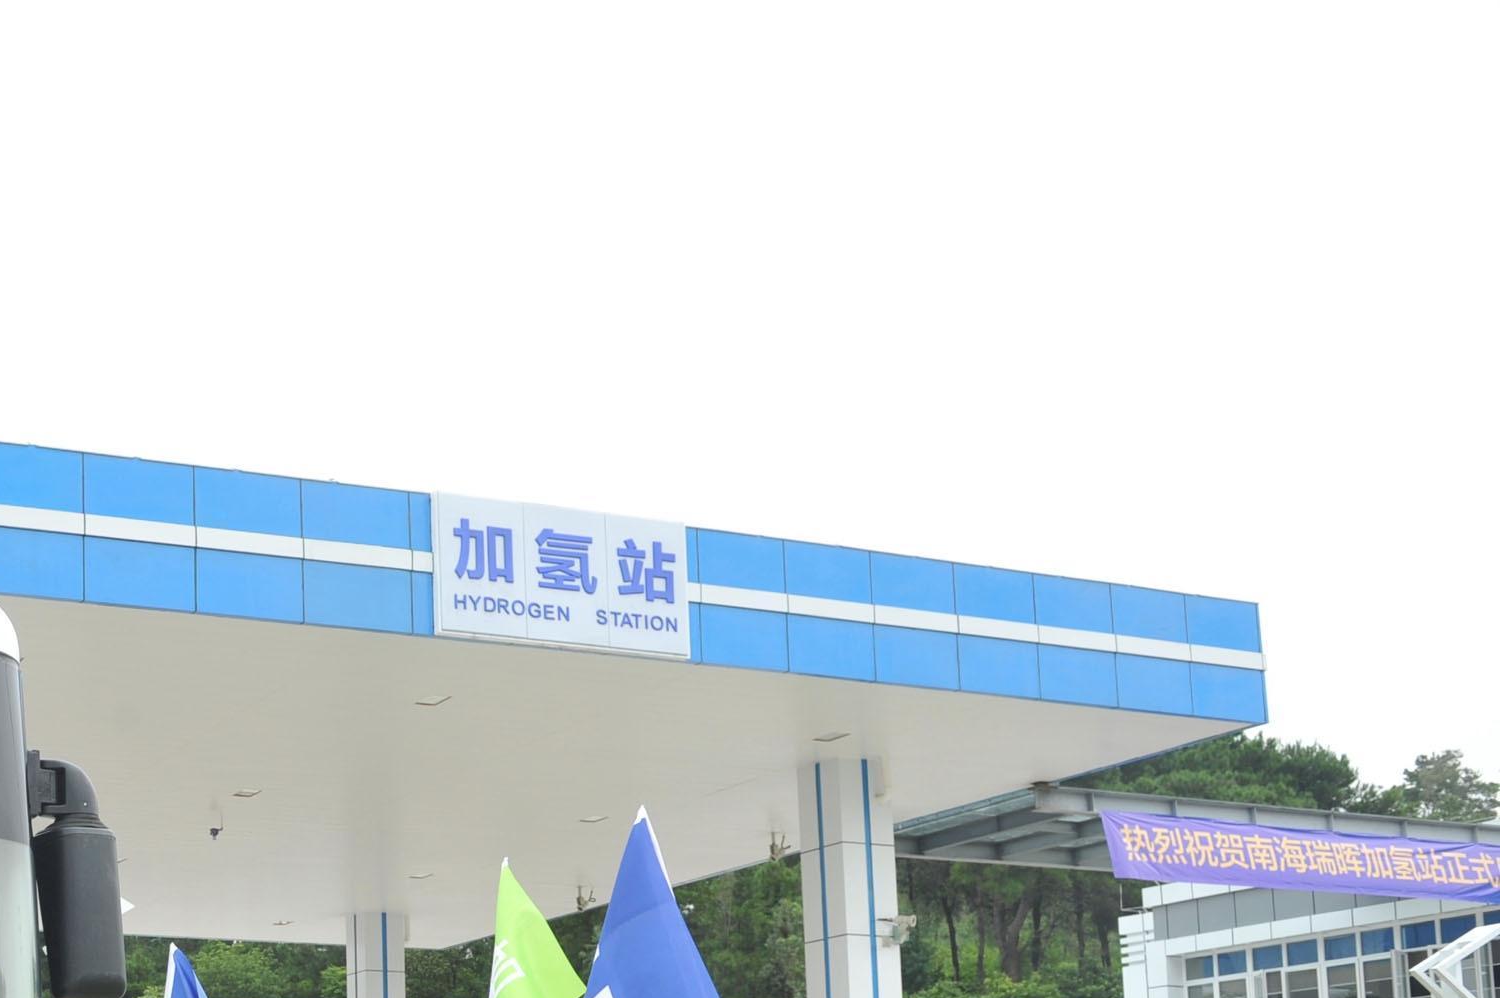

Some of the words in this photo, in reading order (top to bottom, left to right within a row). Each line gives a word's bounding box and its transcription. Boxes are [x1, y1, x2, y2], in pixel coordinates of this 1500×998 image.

[453, 518, 676, 604] 加氢站
[454, 594, 570, 622] HYDROGEN
[596, 609, 679, 633] STATION
[1120, 823, 1500, 889] 热烈祝贺南海瑞晖加氢站正式
